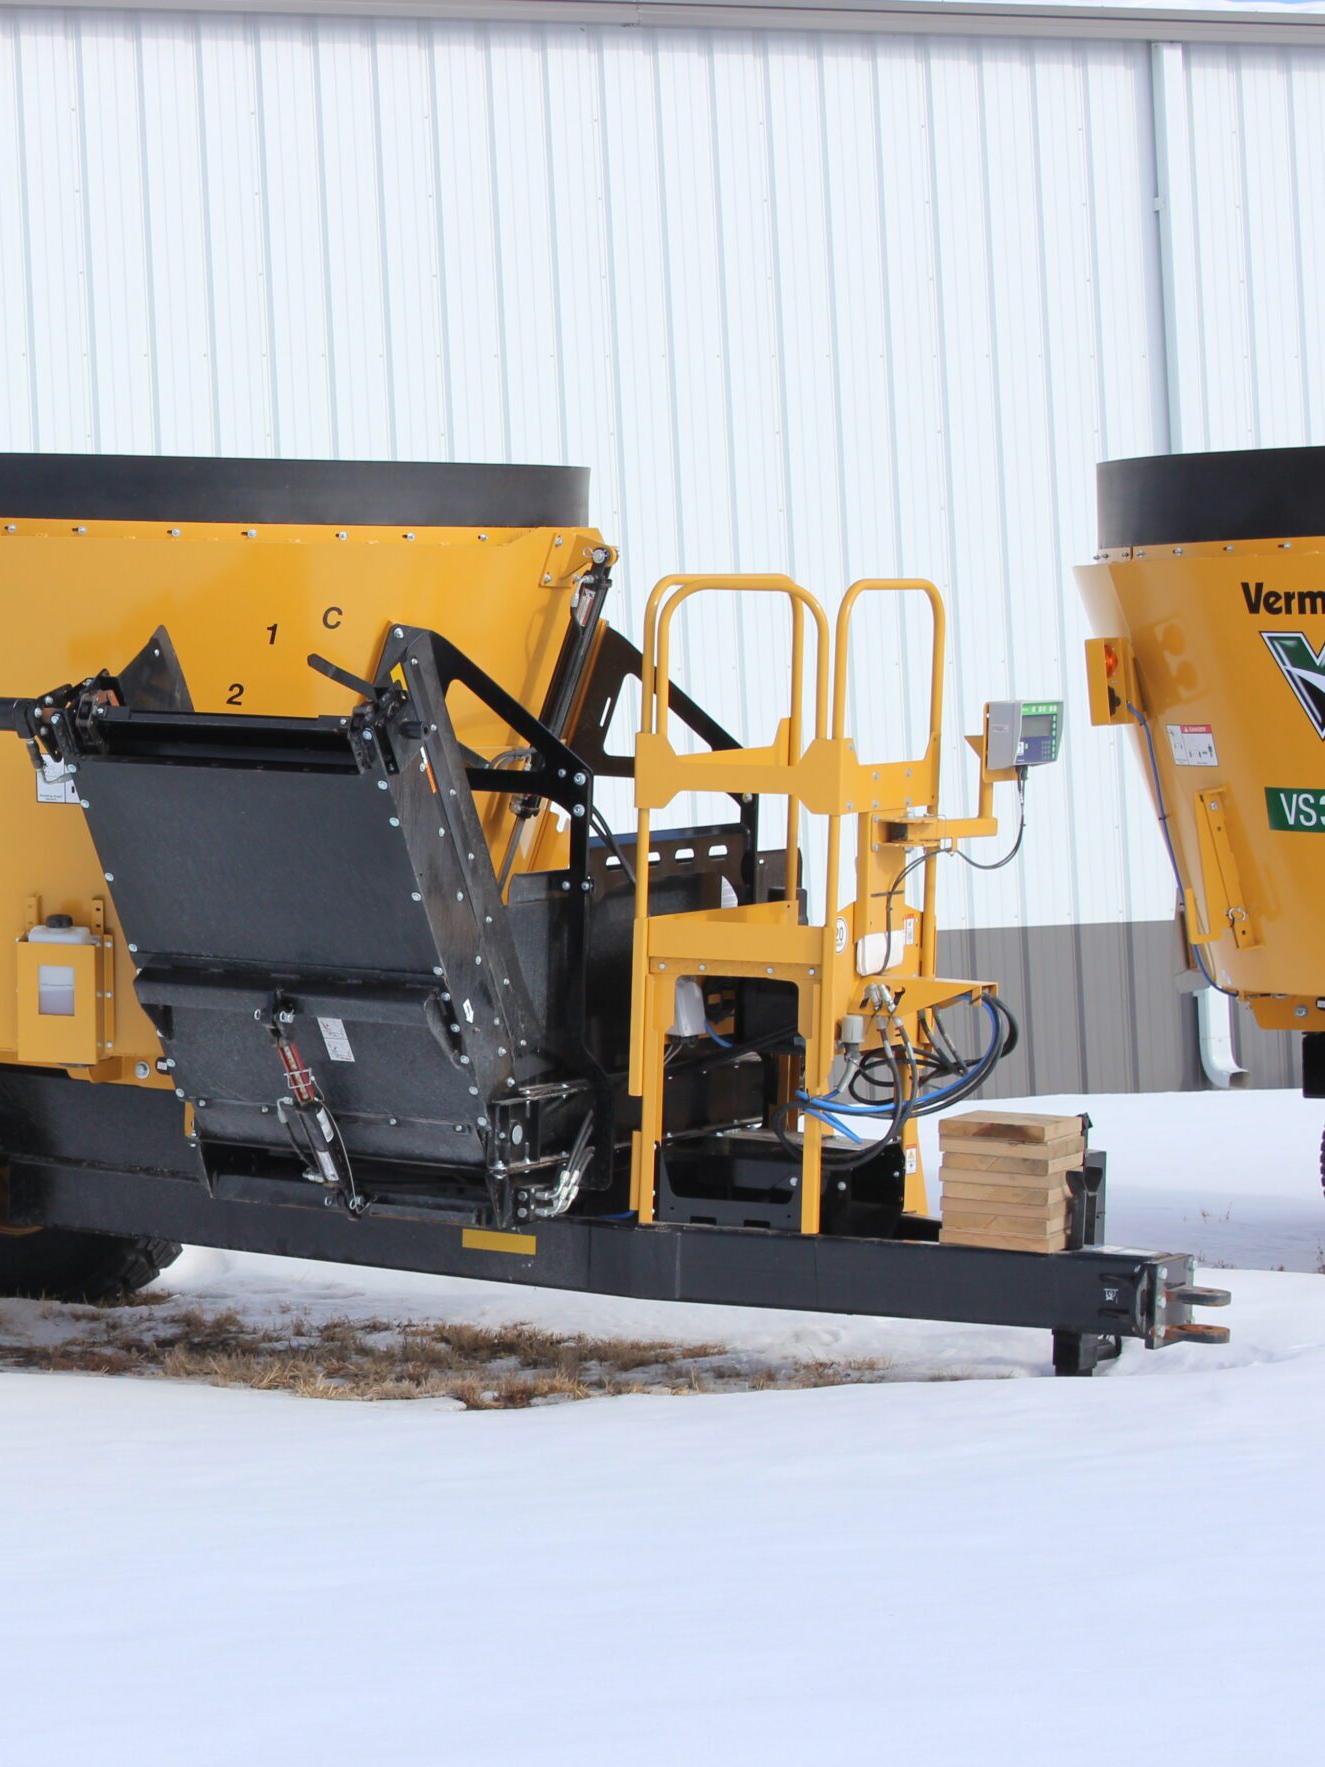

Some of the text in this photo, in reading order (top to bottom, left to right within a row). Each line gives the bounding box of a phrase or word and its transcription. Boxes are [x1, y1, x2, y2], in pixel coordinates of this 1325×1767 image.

[322, 606, 343, 629] C
[267, 623, 278, 645] 1
[226, 683, 244, 706] 2
